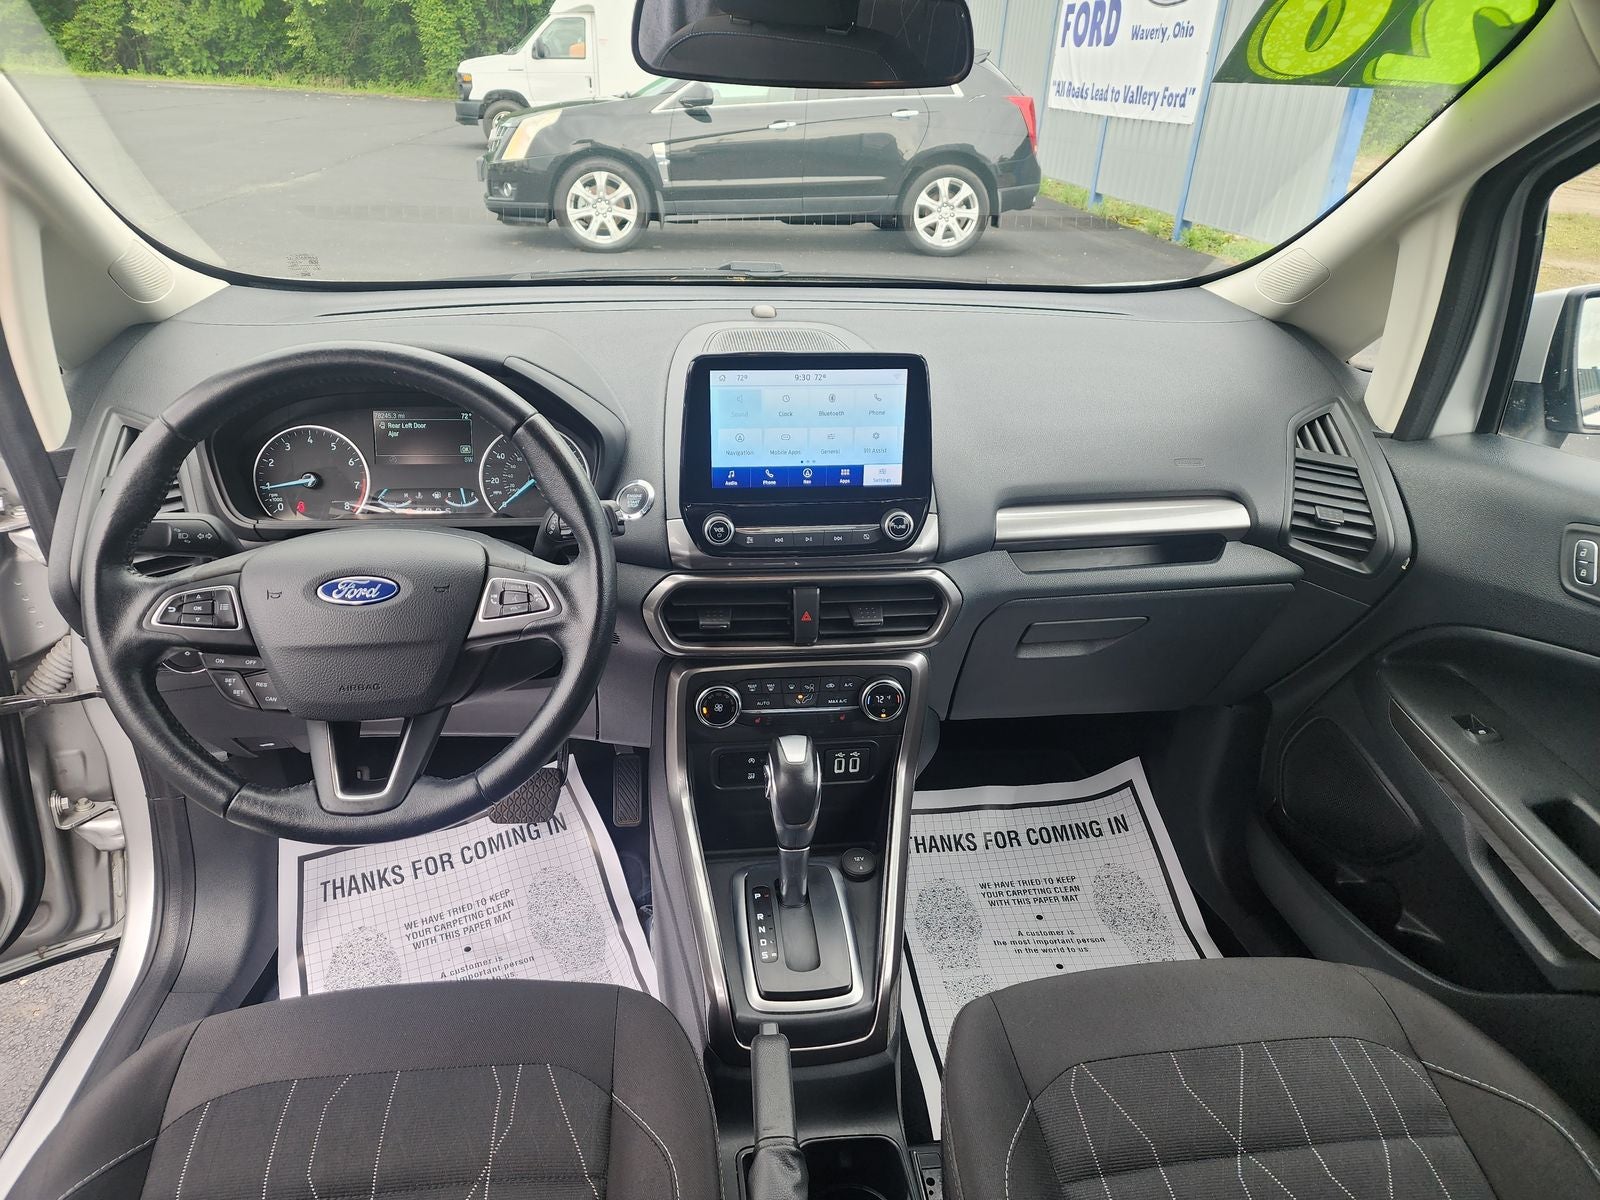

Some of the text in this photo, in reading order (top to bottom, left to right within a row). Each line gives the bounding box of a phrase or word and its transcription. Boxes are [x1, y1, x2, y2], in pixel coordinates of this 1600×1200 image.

[1060, 0, 1122, 48] FORD
[1130, 21, 1194, 43] Waverly, Ohio
[1066, 81, 1089, 100] Roads
[1090, 83, 1110, 102] Lead
[1111, 86, 1121, 103] to
[1122, 84, 1160, 111] Vallery
[794, 373, 811, 381] 9:30
[307, 436, 313, 444] 4
[387, 430, 399, 438] Ajar
[285, 443, 291, 451] 3
[331, 443, 337, 451] 5
[268, 459, 274, 467] 2
[348, 458, 355, 466] 6
[277, 503, 284, 511] 0
[344, 502, 350, 510] 8
[332, 579, 382, 599] Ford
[339, 682, 381, 691] AIRBAG
[983, 830, 1022, 849] FOR
[1026, 820, 1104, 845] COMING
[1107, 813, 1130, 835] IN
[320, 812, 567, 902] THANKS FOR COMING IN
[994, 880, 1015, 888] HAVE
[1043, 877, 1054, 885] TO
[1056, 875, 1076, 883] KEEP
[1006, 888, 1053, 897] CARPETING
[1053, 885, 1080, 894] CLEAN
[988, 894, 1079, 907] WITH THIS PAPER MAT
[404, 888, 511, 930] WE HAVE TRIED TO KEEP
[405, 899, 514, 942] YOUR CARPETING CLEAN
[412, 911, 513, 950] WITH THIS PAPER MAT
[1033, 938, 1075, 946] important
[1076, 937, 1106, 945] person
[440, 971, 447, 979] A
[449, 958, 492, 976] customer
[504, 955, 535, 970] person
